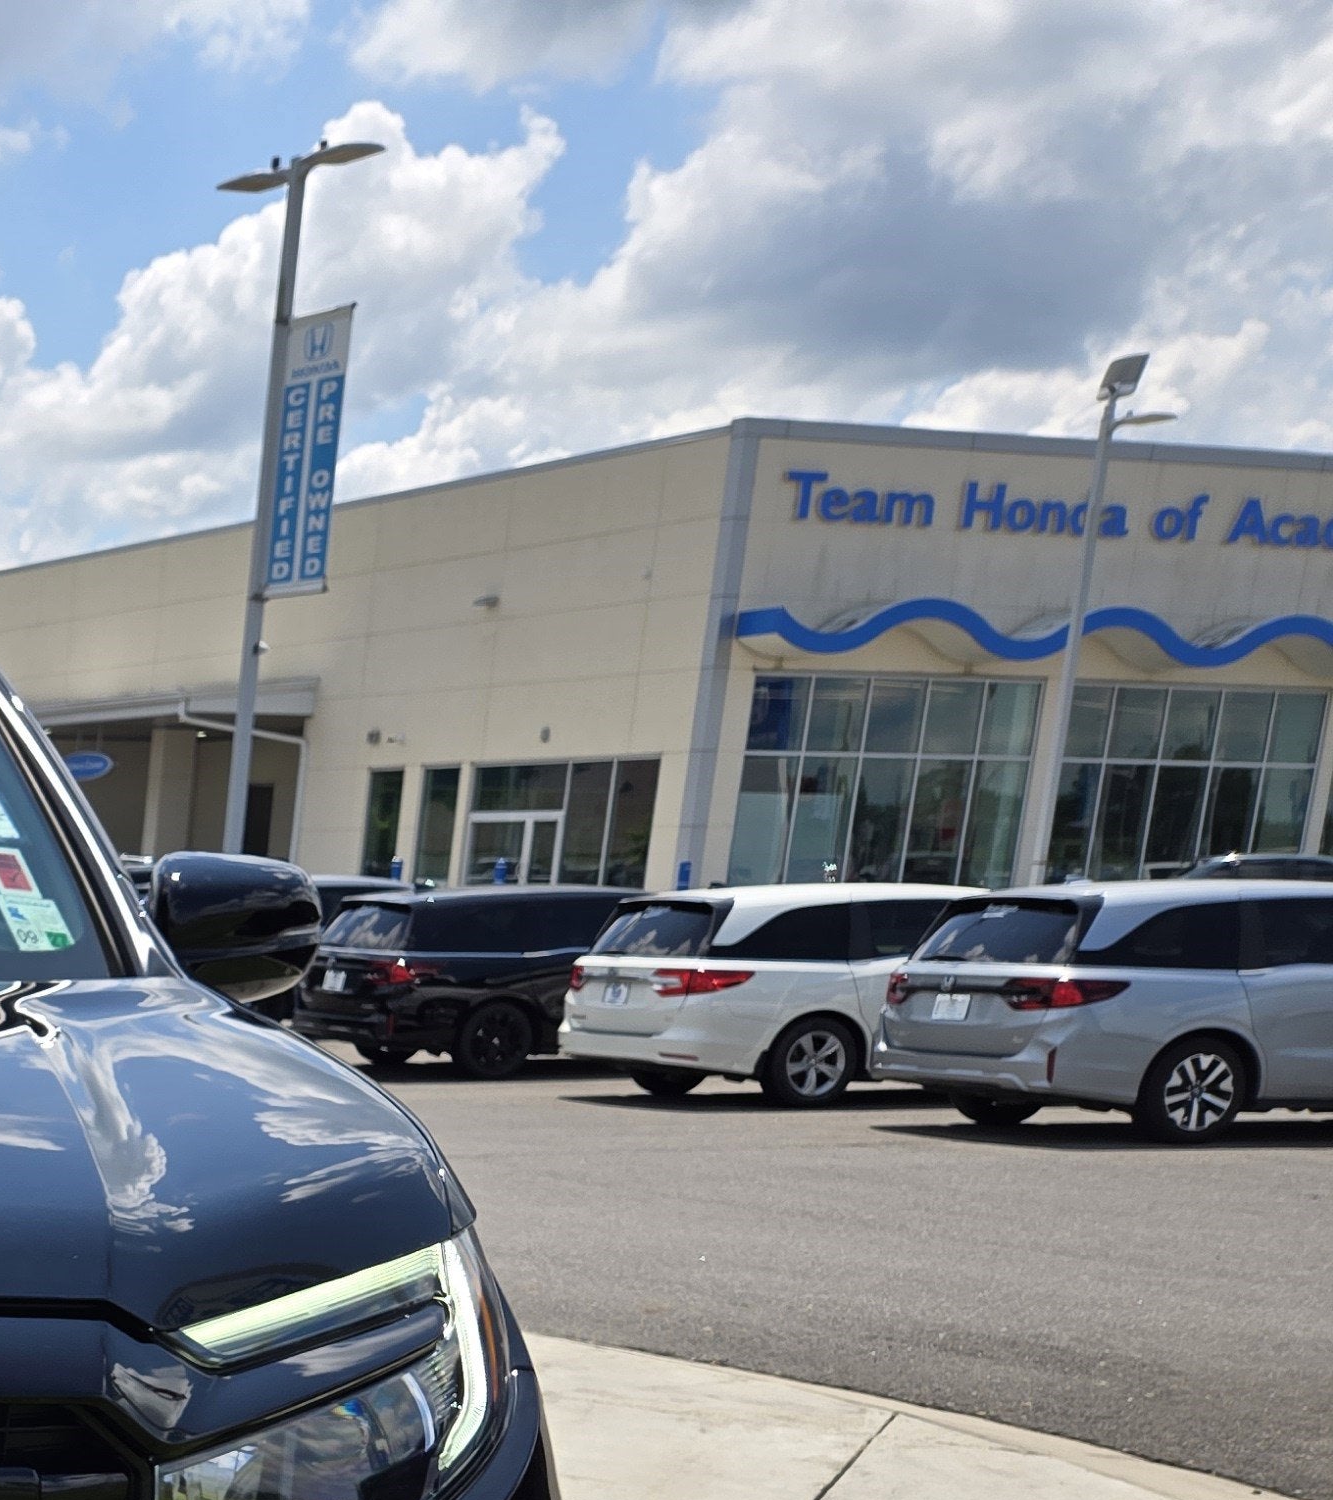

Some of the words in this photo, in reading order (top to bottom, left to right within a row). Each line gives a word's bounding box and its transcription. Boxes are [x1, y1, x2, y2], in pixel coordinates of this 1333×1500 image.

[317, 381, 338, 444] PRE
[273, 387, 307, 579] CERTIFIED
[305, 469, 330, 575] OWNED
[787, 470, 934, 527] Team
[1152, 494, 1209, 541] of
